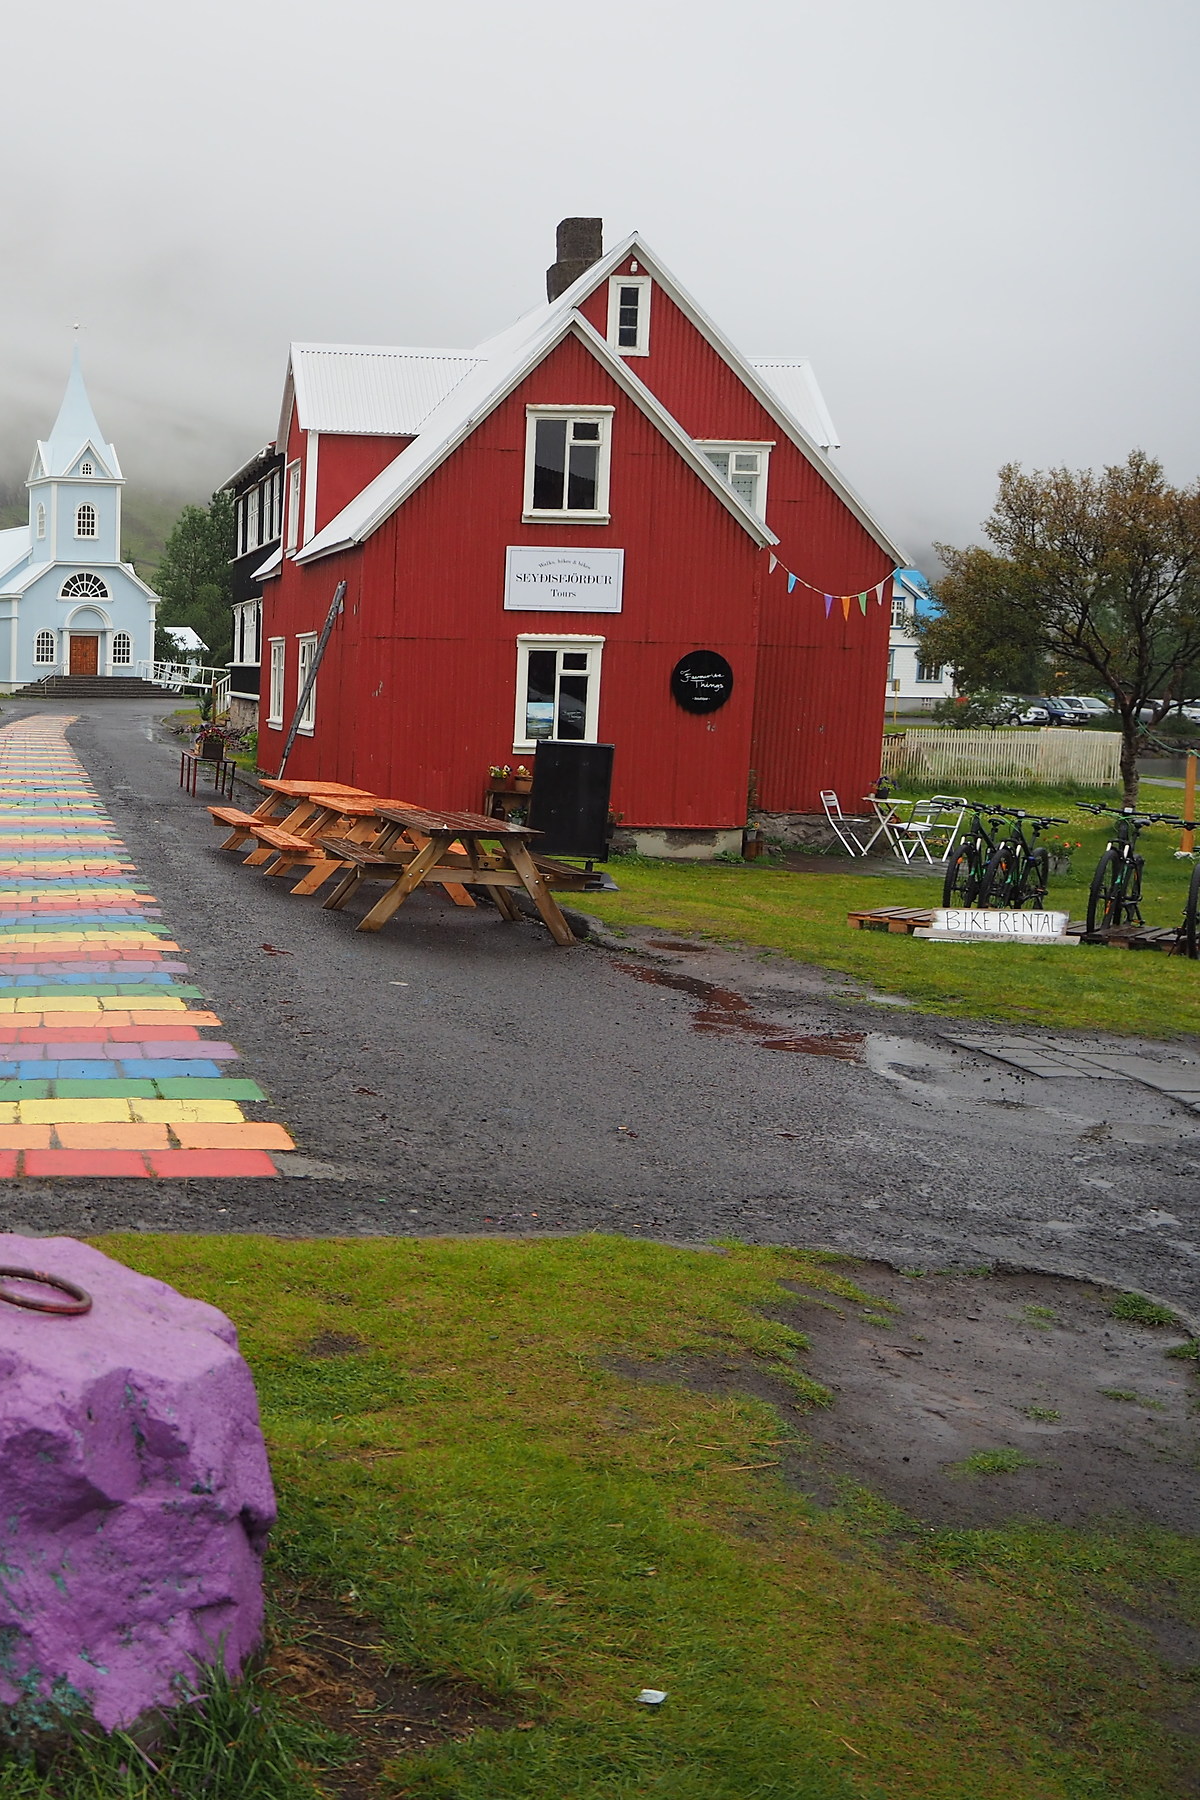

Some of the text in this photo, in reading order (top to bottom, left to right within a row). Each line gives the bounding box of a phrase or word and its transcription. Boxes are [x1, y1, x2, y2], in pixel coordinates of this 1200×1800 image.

[550, 588, 577, 598] Tours
[690, 679, 724, 692] Things
[945, 910, 1059, 933] BIKE RENTAL
